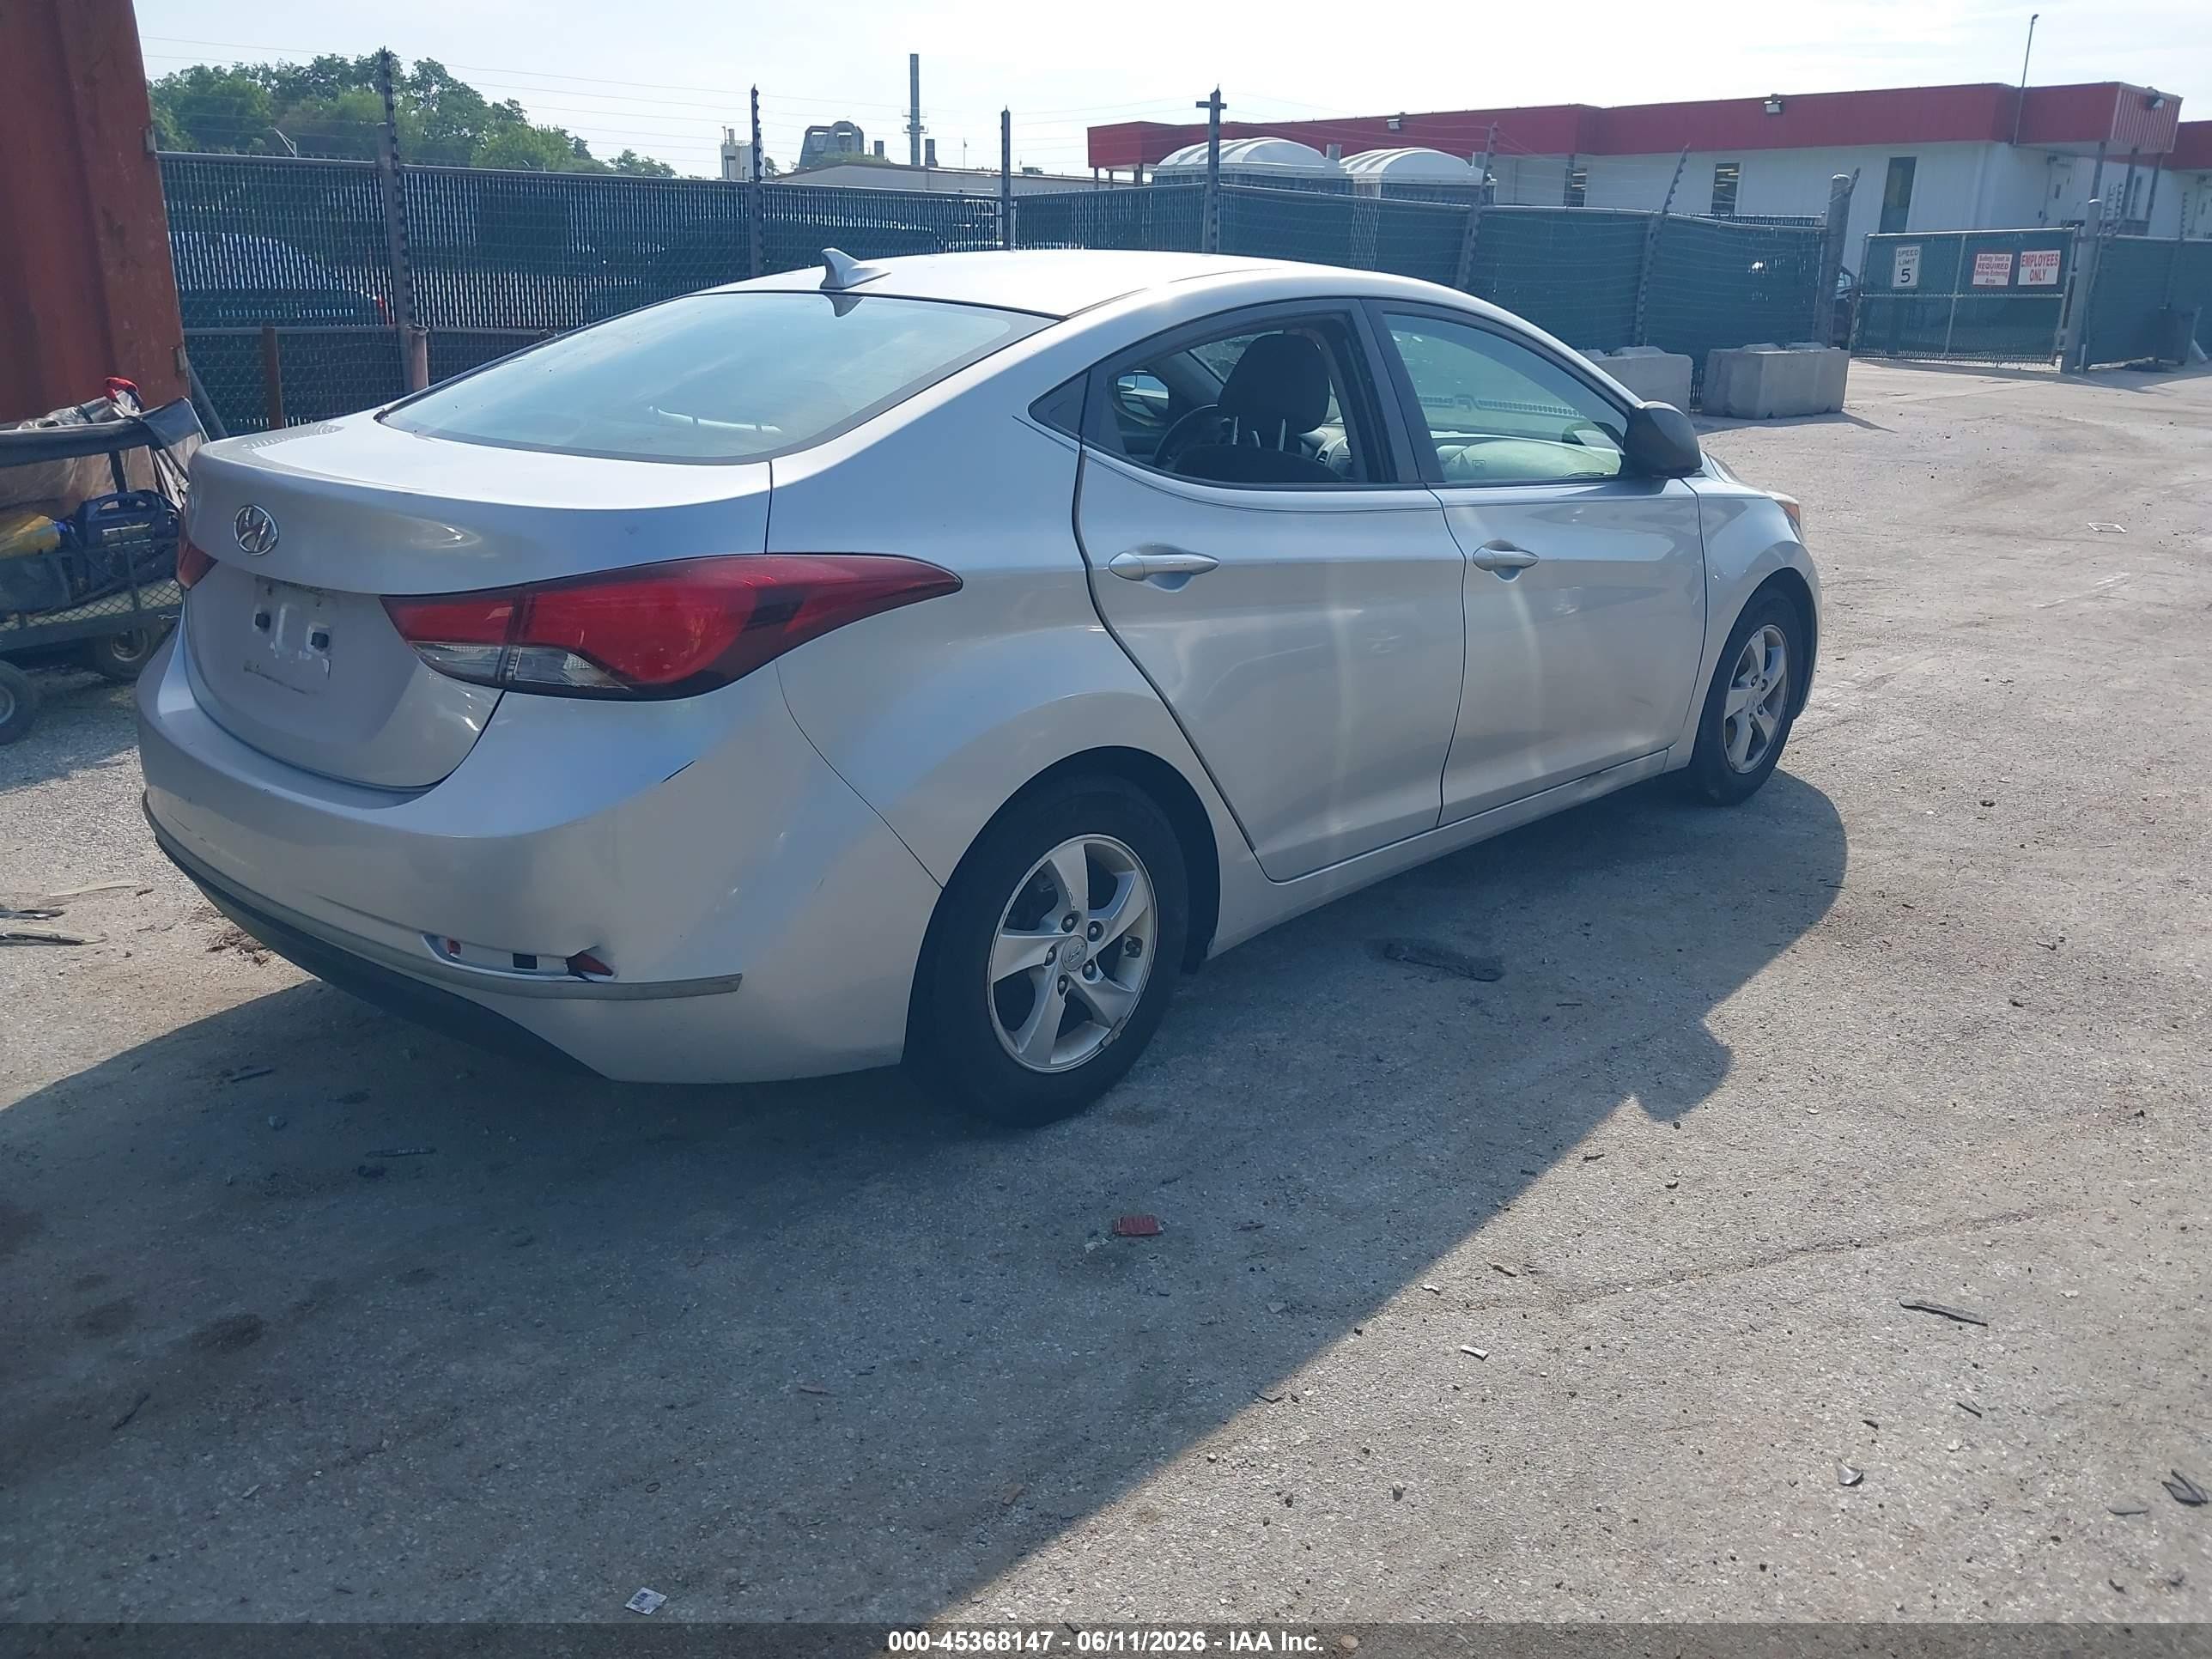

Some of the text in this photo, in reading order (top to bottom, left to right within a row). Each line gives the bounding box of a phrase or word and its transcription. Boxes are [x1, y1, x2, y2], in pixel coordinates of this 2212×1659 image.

[1898, 258, 1916, 266] LIMIT
[2021, 254, 2059, 267] EMPLOYEES
[1900, 268, 1911, 283] 5
[2029, 269, 2047, 282] ONLY
